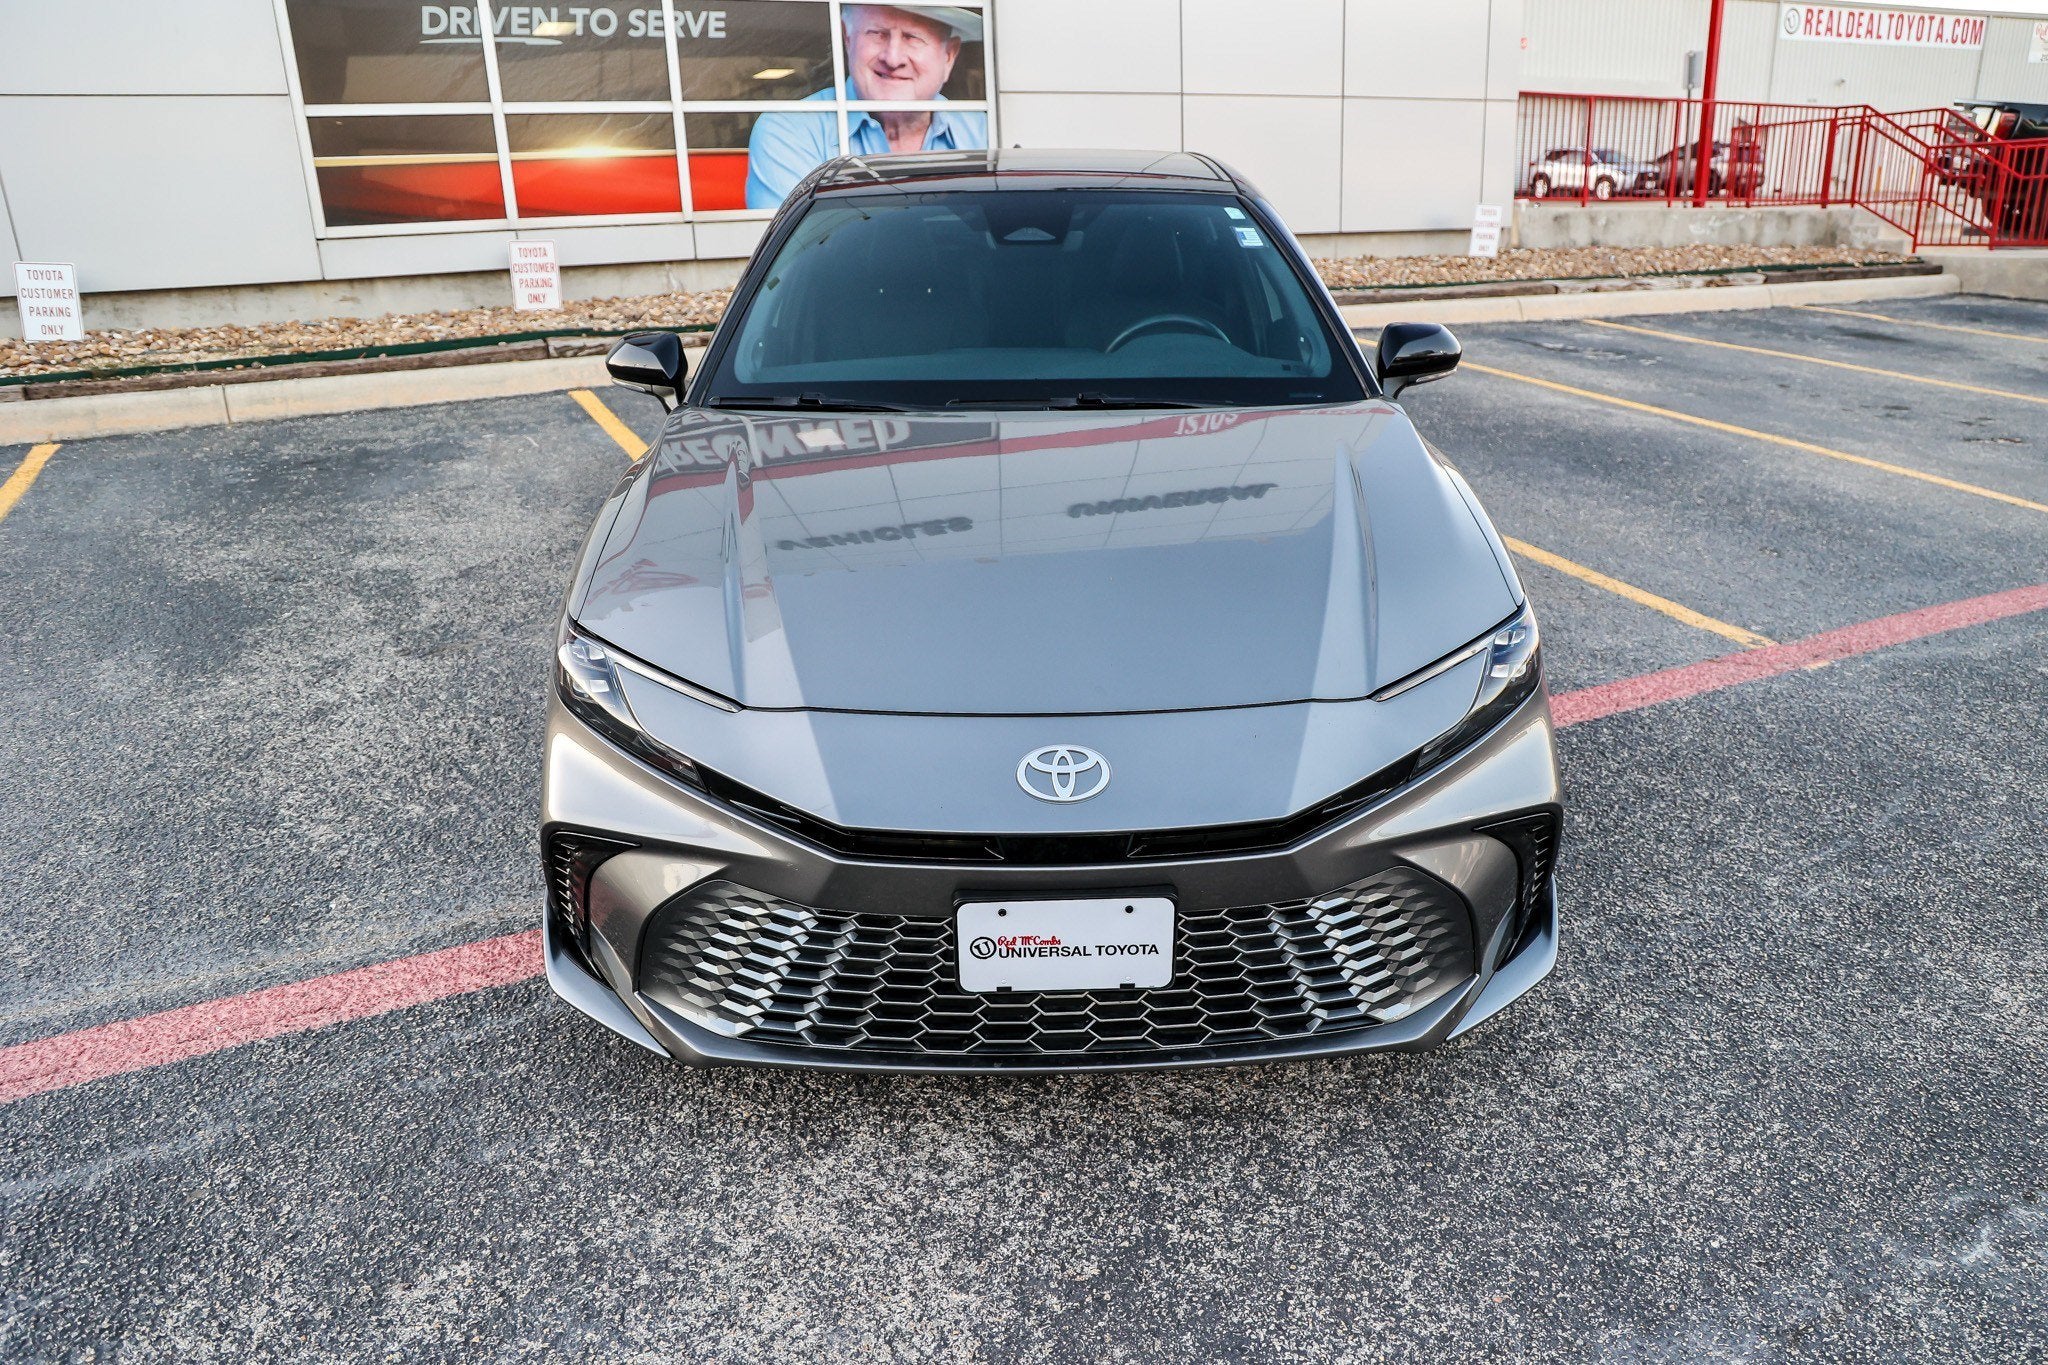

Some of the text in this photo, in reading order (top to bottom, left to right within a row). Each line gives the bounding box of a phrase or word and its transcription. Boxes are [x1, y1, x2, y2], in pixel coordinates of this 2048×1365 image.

[421, 5, 727, 39] DRIVEN TO SERVE
[1802, 8, 1984, 45] REALDEALTOYOTA.COM
[517, 248, 548, 257] TOYOTA
[512, 263, 555, 273] CUSTOMER
[26, 270, 63, 280] TOYOTA
[518, 278, 552, 288] PARKING
[20, 288, 74, 299] CUSTOMER
[528, 294, 546, 303] ONLY
[29, 306, 71, 317] PARKING
[40, 325, 64, 335] ONLY
[997, 936, 1017, 949] Red
[998, 944, 1159, 958] UNIVERSAL TOYOTA
